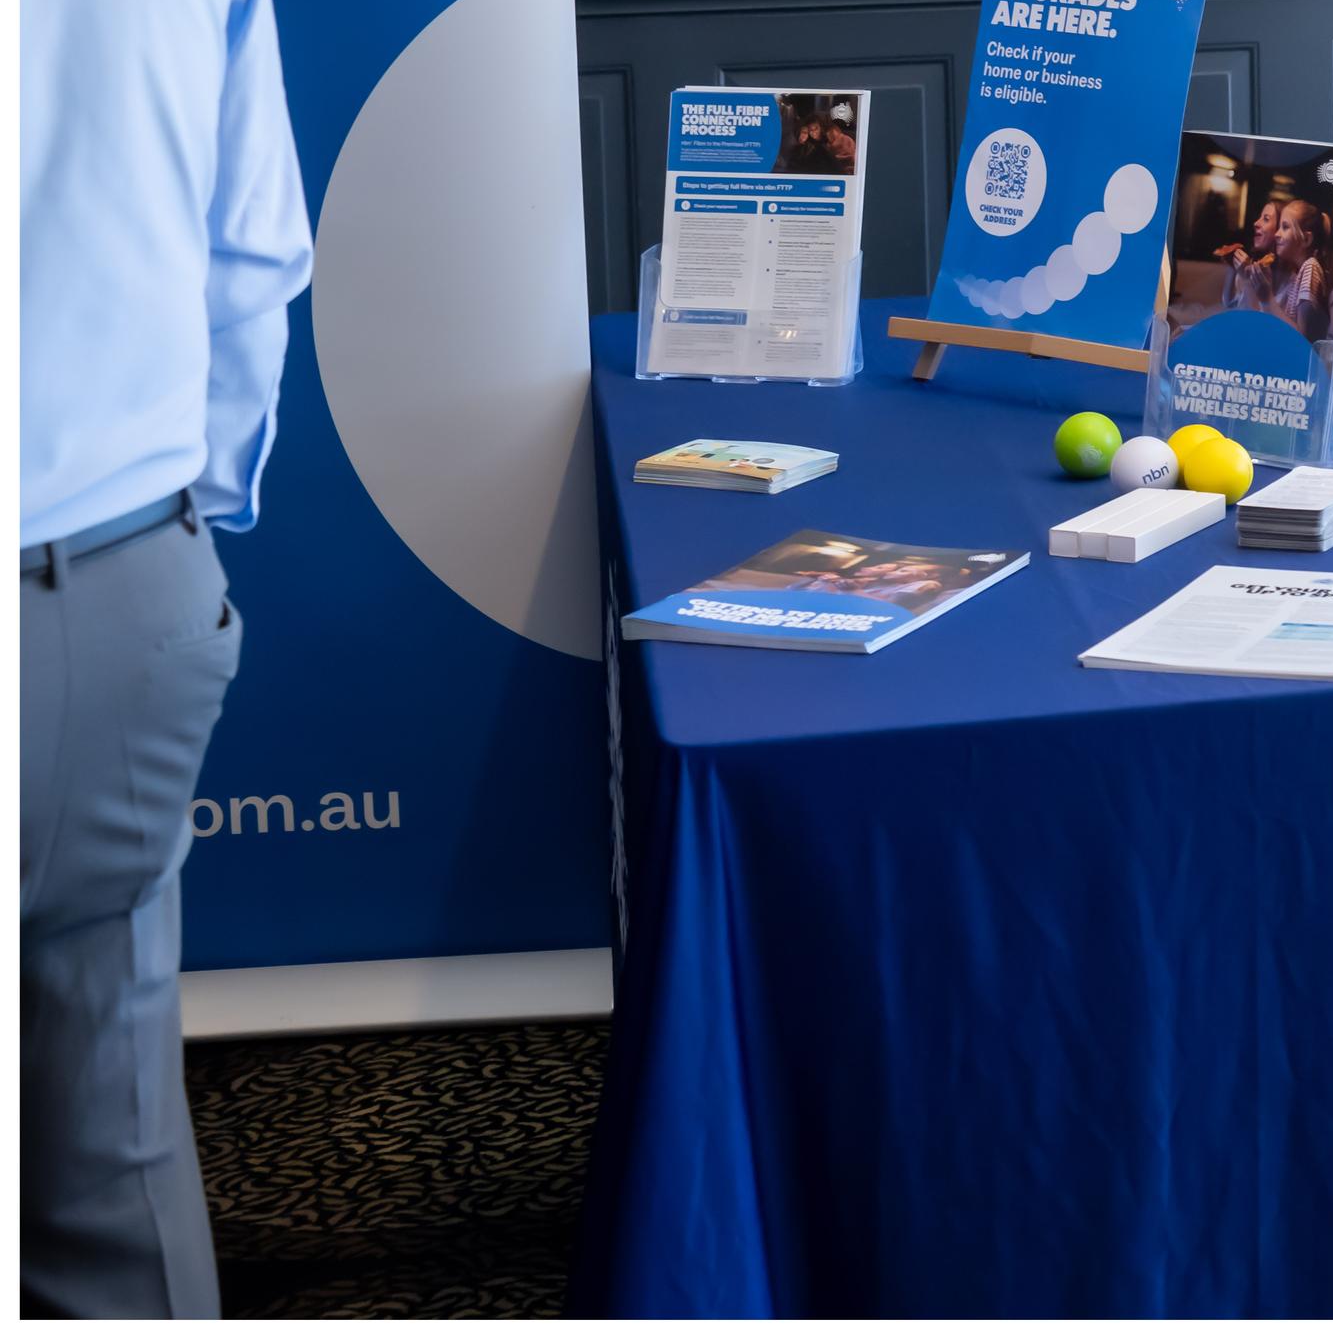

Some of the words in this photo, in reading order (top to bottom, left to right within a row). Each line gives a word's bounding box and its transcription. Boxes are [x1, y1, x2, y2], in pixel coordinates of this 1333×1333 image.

[991, 0, 1044, 30] ARE
[1046, 6, 1118, 38] HERE.
[986, 41, 1029, 60] Check
[1031, 46, 1043, 61] if
[1042, 50, 1076, 66] your
[983, 61, 1022, 80] home
[1024, 69, 1040, 82] or
[1041, 68, 1103, 90] business
[980, 81, 992, 98] is
[994, 84, 1047, 105] eligible.
[681, 104, 706, 115] THE
[706, 105, 734, 116] FULL
[735, 106, 770, 117] FIBRE
[681, 114, 762, 127] CONNECTION
[681, 124, 737, 136] PROCESS
[777, 184, 794, 192] FTTP
[979, 204, 1002, 213] CHECK
[1003, 208, 1024, 217] YOUR
[983, 214, 1016, 225] ADDRESS
[1173, 363, 1242, 385] GETTING
[1244, 372, 1265, 389] TO
[1266, 375, 1316, 398] KNOW
[1179, 379, 1223, 402] YOUR
[1264, 391, 1307, 413] FIXED
[1174, 395, 1249, 421] WIRELESS
[1250, 406, 1310, 430] SERVICE
[1142, 464, 1170, 484] nbn
